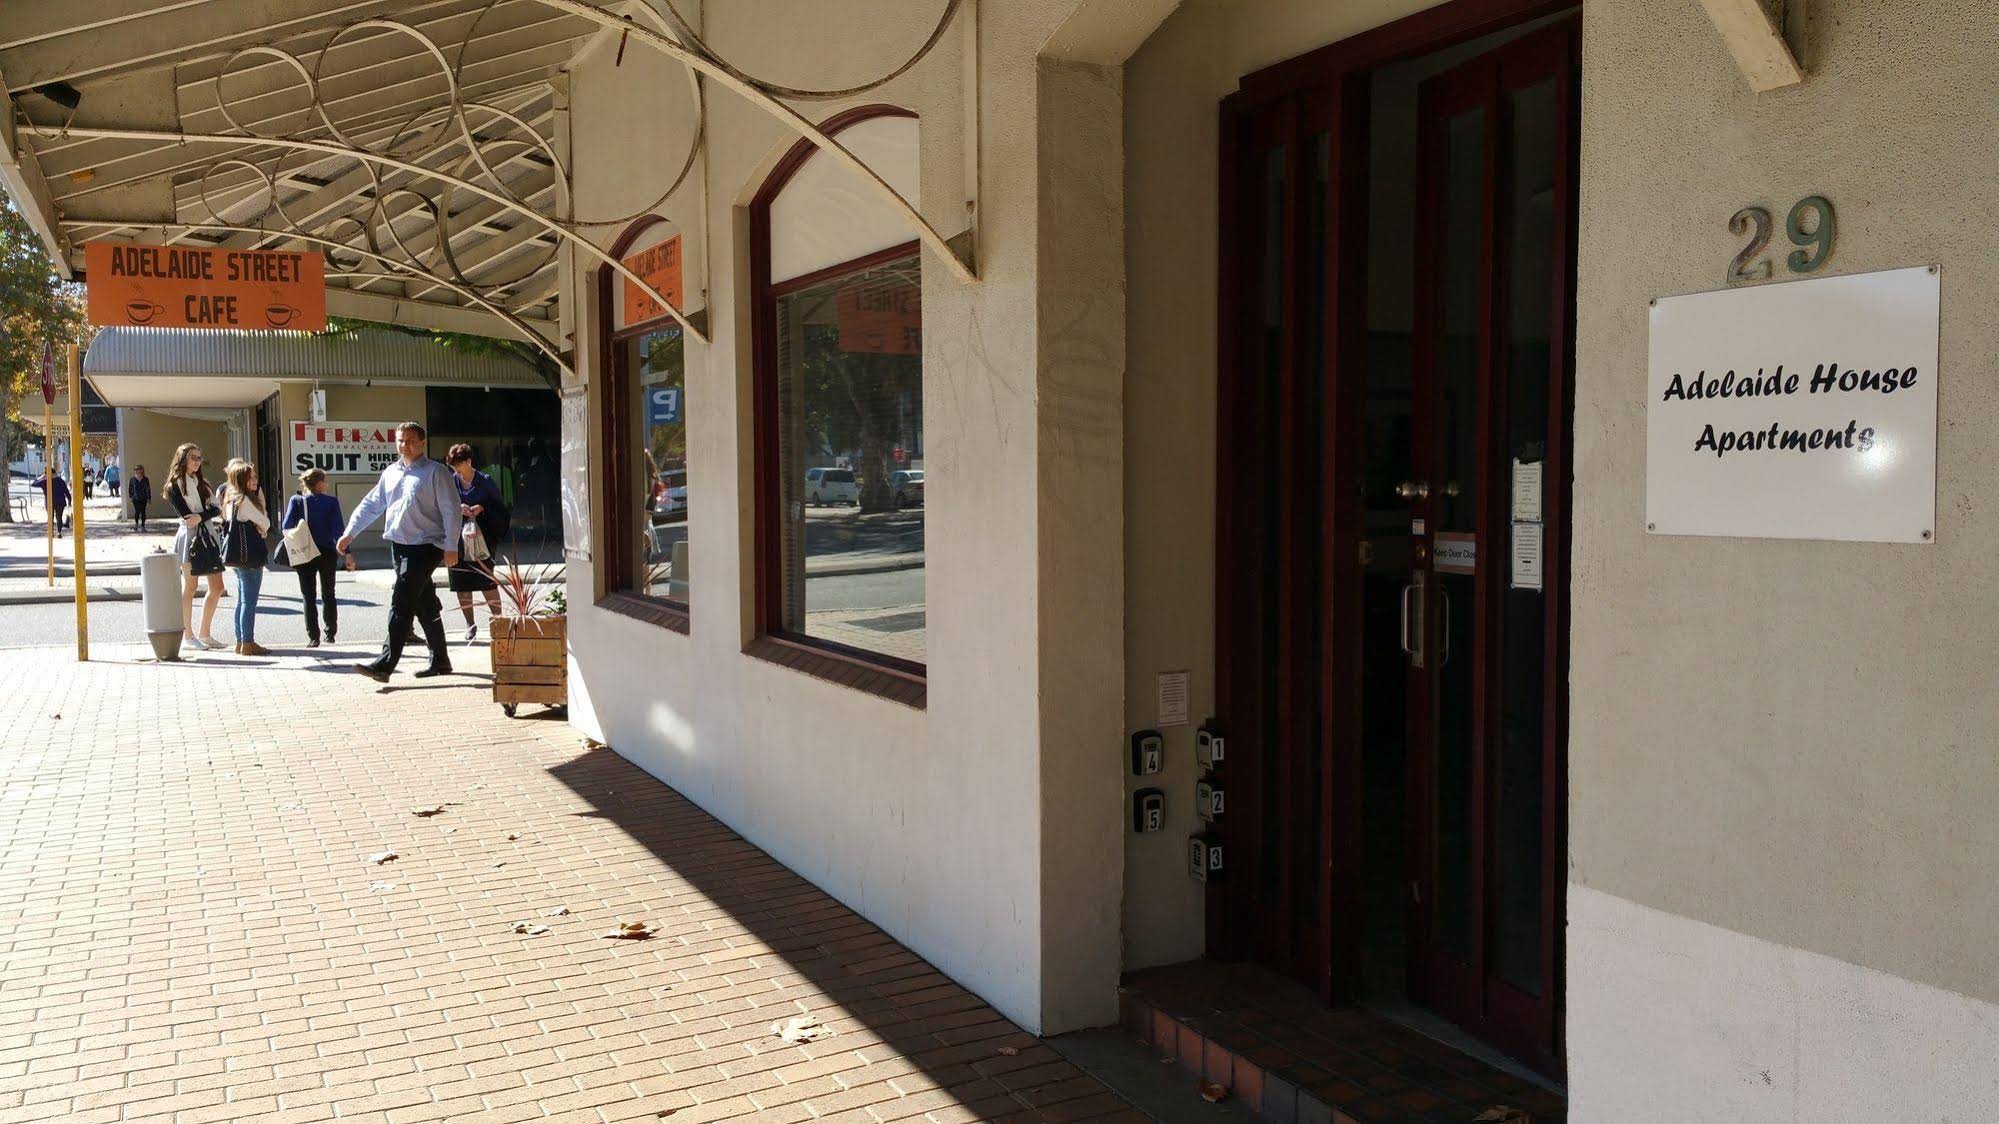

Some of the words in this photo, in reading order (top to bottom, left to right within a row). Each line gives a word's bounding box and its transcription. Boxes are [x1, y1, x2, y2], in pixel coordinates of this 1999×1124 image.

[1727, 195, 1836, 283] 29
[111, 247, 213, 280] ADELAIDE
[227, 252, 302, 283] STREET
[184, 295, 238, 324] CAFE
[1663, 365, 1800, 401] Adelaide
[1810, 363, 1918, 393] House
[1694, 420, 1875, 458] Apartments
[296, 453, 361, 471] SUIT
[368, 453, 398, 462] HIRE
[1449, 548, 1462, 558] Door
[1214, 740, 1221, 758] 1
[1149, 753, 1157, 771] 4
[1214, 793, 1222, 811] 2
[1150, 811, 1158, 830] 5
[1212, 849, 1220, 868] 3
